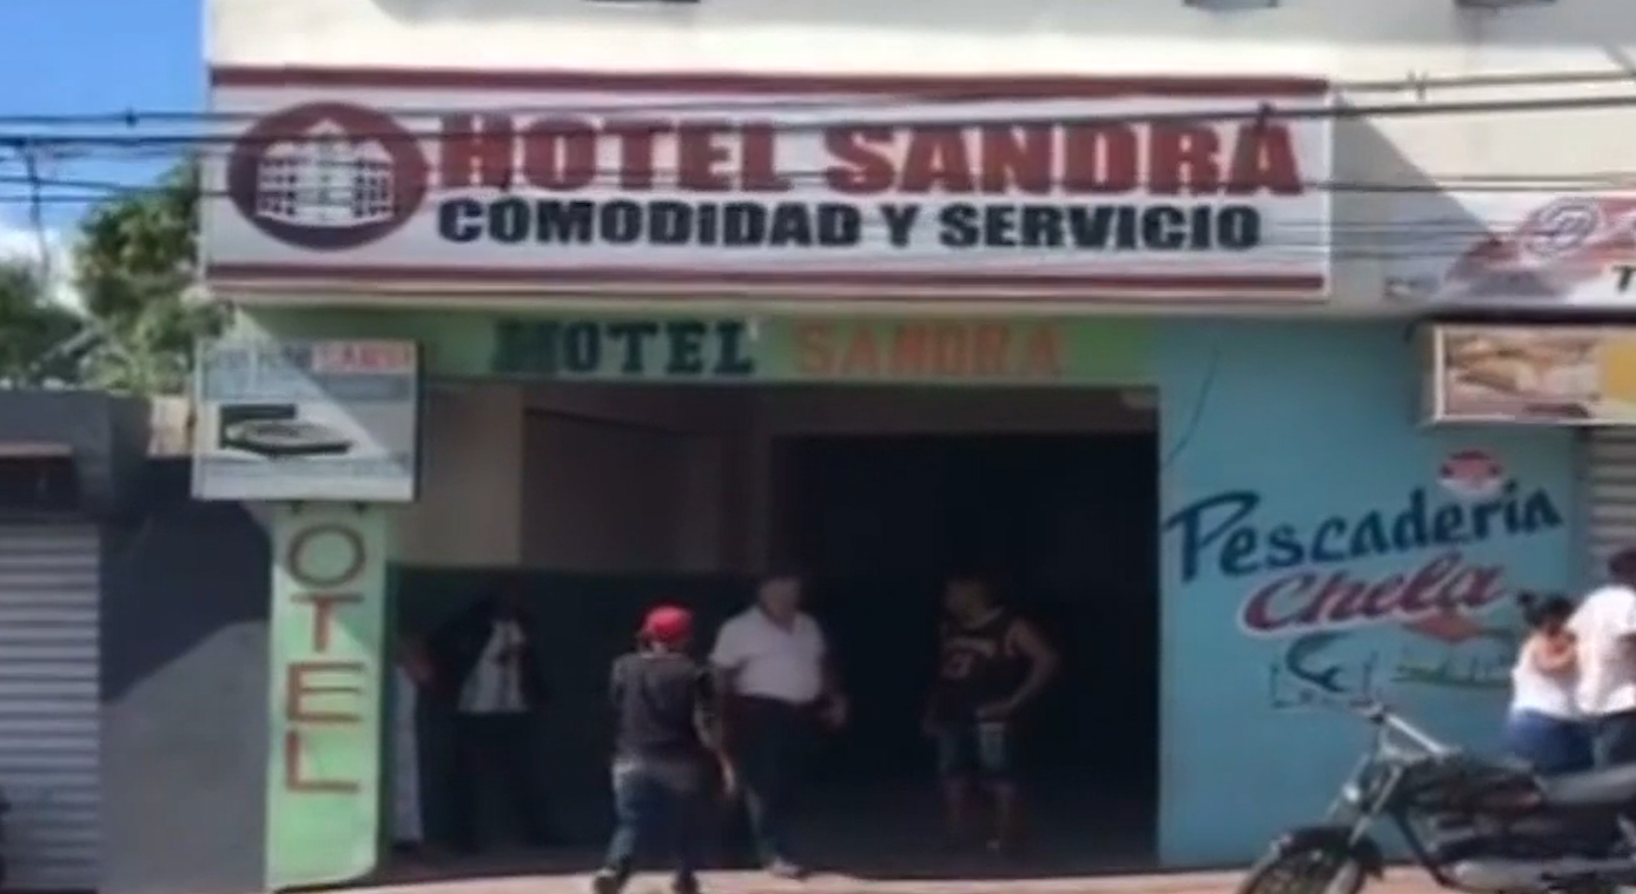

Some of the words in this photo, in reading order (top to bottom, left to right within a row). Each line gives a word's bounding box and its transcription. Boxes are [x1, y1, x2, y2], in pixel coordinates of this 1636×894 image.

[437, 112, 790, 192] HOTEL
[824, 122, 1302, 194] SANDRA
[438, 198, 861, 247] COMODIDAD
[881, 203, 920, 248] Y
[939, 204, 1261, 249] SERVICIO
[795, 324, 1060, 375] SANDRA
[1241, 550, 1505, 633] Chela
[286, 502, 366, 795] OTEL
